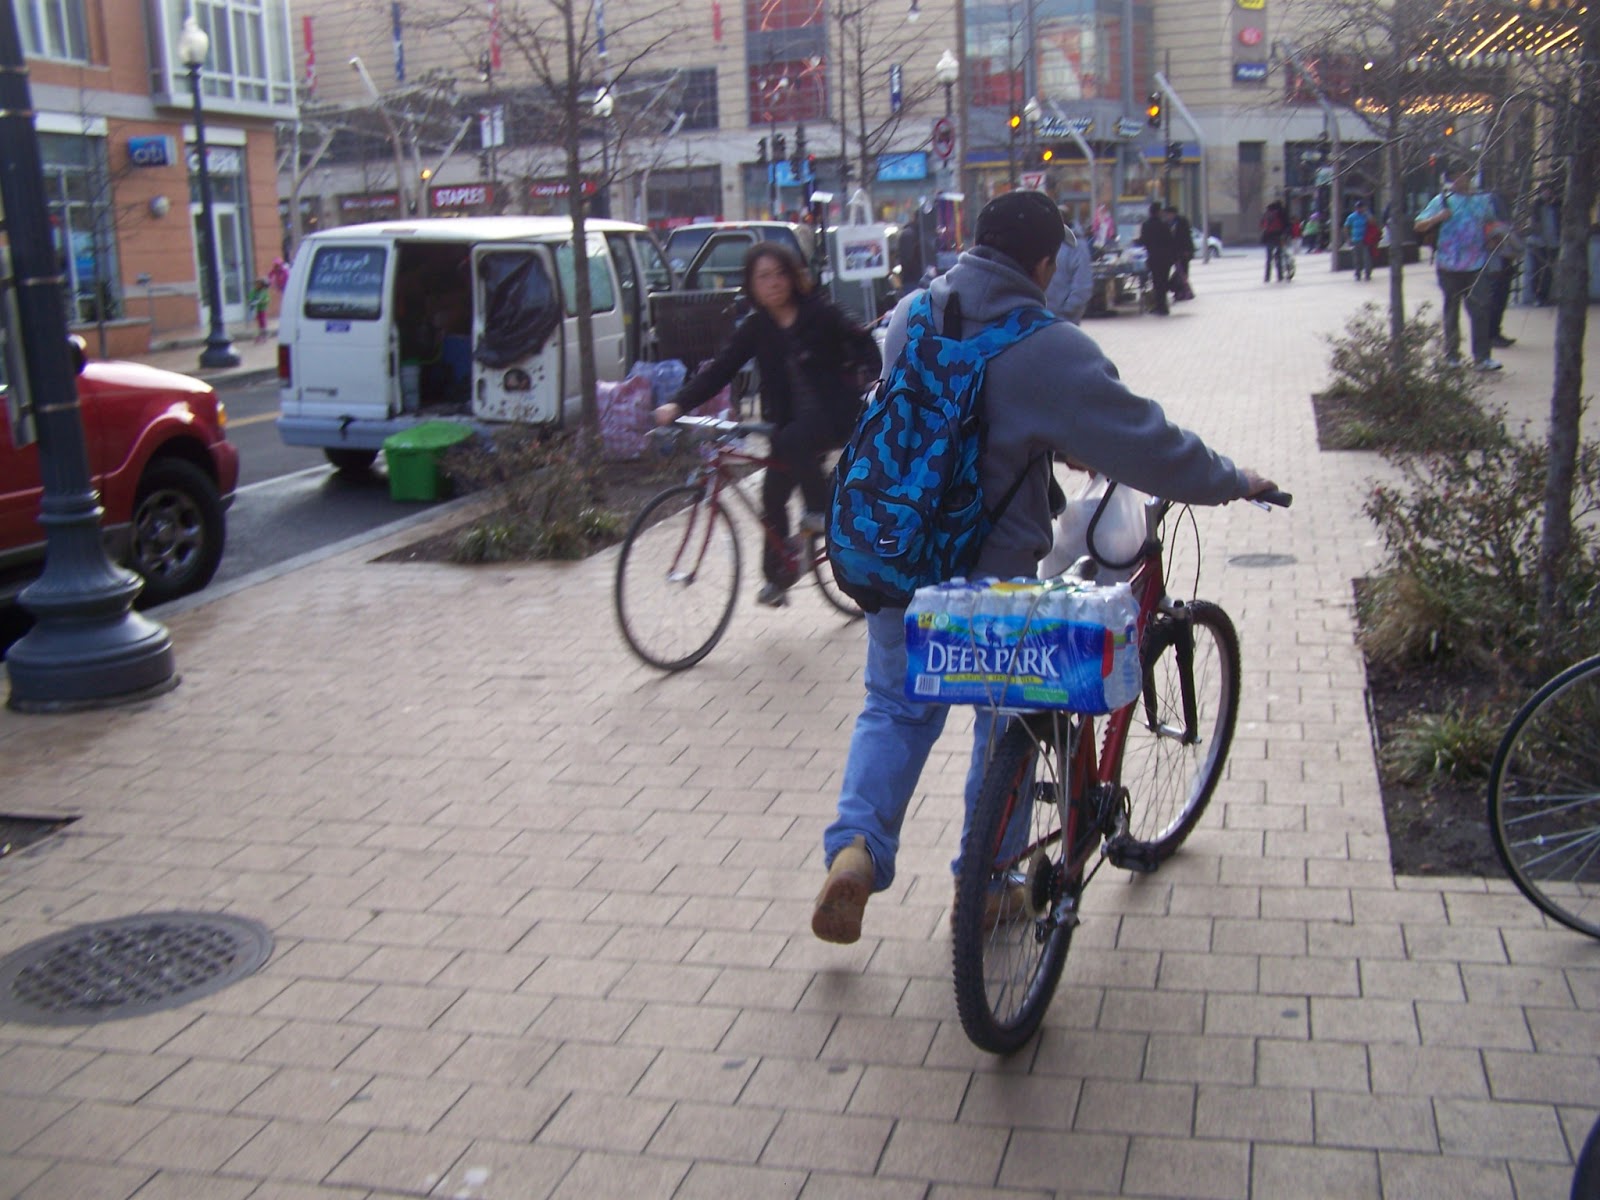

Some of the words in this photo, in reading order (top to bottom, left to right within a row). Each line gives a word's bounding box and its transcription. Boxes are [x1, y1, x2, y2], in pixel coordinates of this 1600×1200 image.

[436, 187, 486, 207] STAPLES
[926, 640, 992, 673] DEER
[995, 645, 1060, 677] PARK
